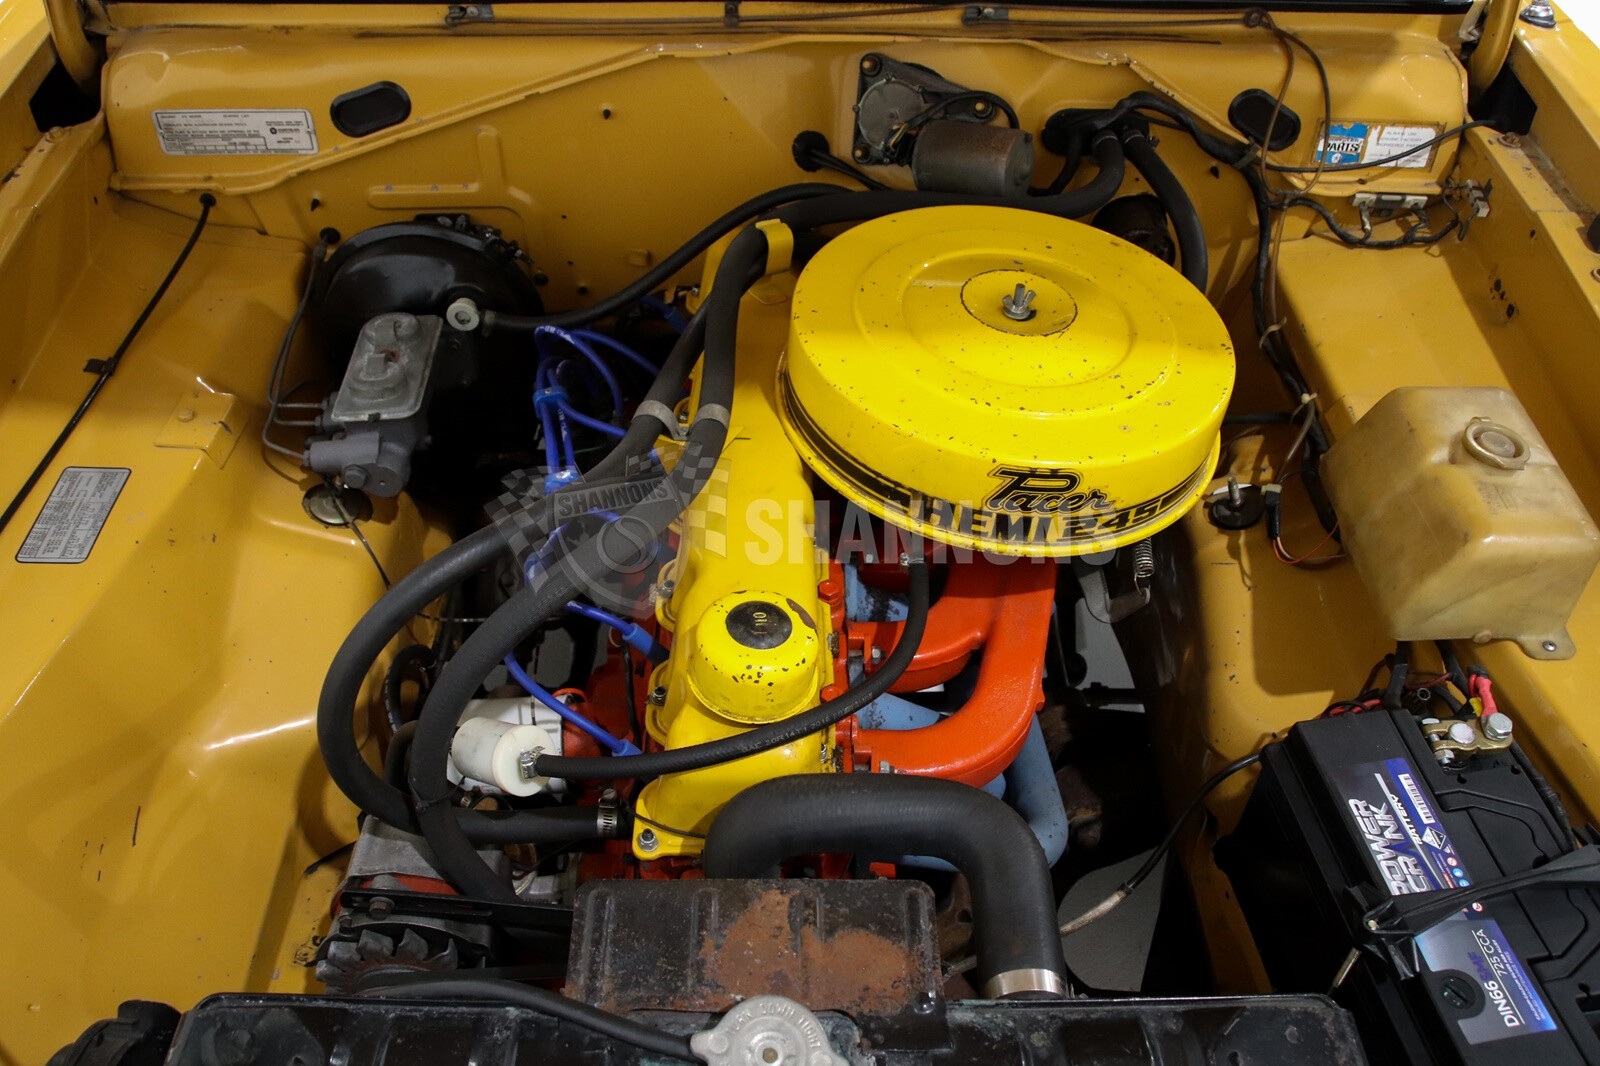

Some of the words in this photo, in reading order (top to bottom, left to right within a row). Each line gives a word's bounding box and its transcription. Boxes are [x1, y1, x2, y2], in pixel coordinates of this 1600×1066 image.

[982, 464, 1112, 515] Pacer
[917, 493, 1055, 543] HEMI
[1062, 503, 1160, 536] 245
[1389, 793, 1424, 845] BATTERY
[1348, 798, 1410, 896] POWER
[1476, 928, 1495, 954] CCA
[1492, 955, 1508, 977] 725
[1484, 980, 1521, 1028] DIN66
